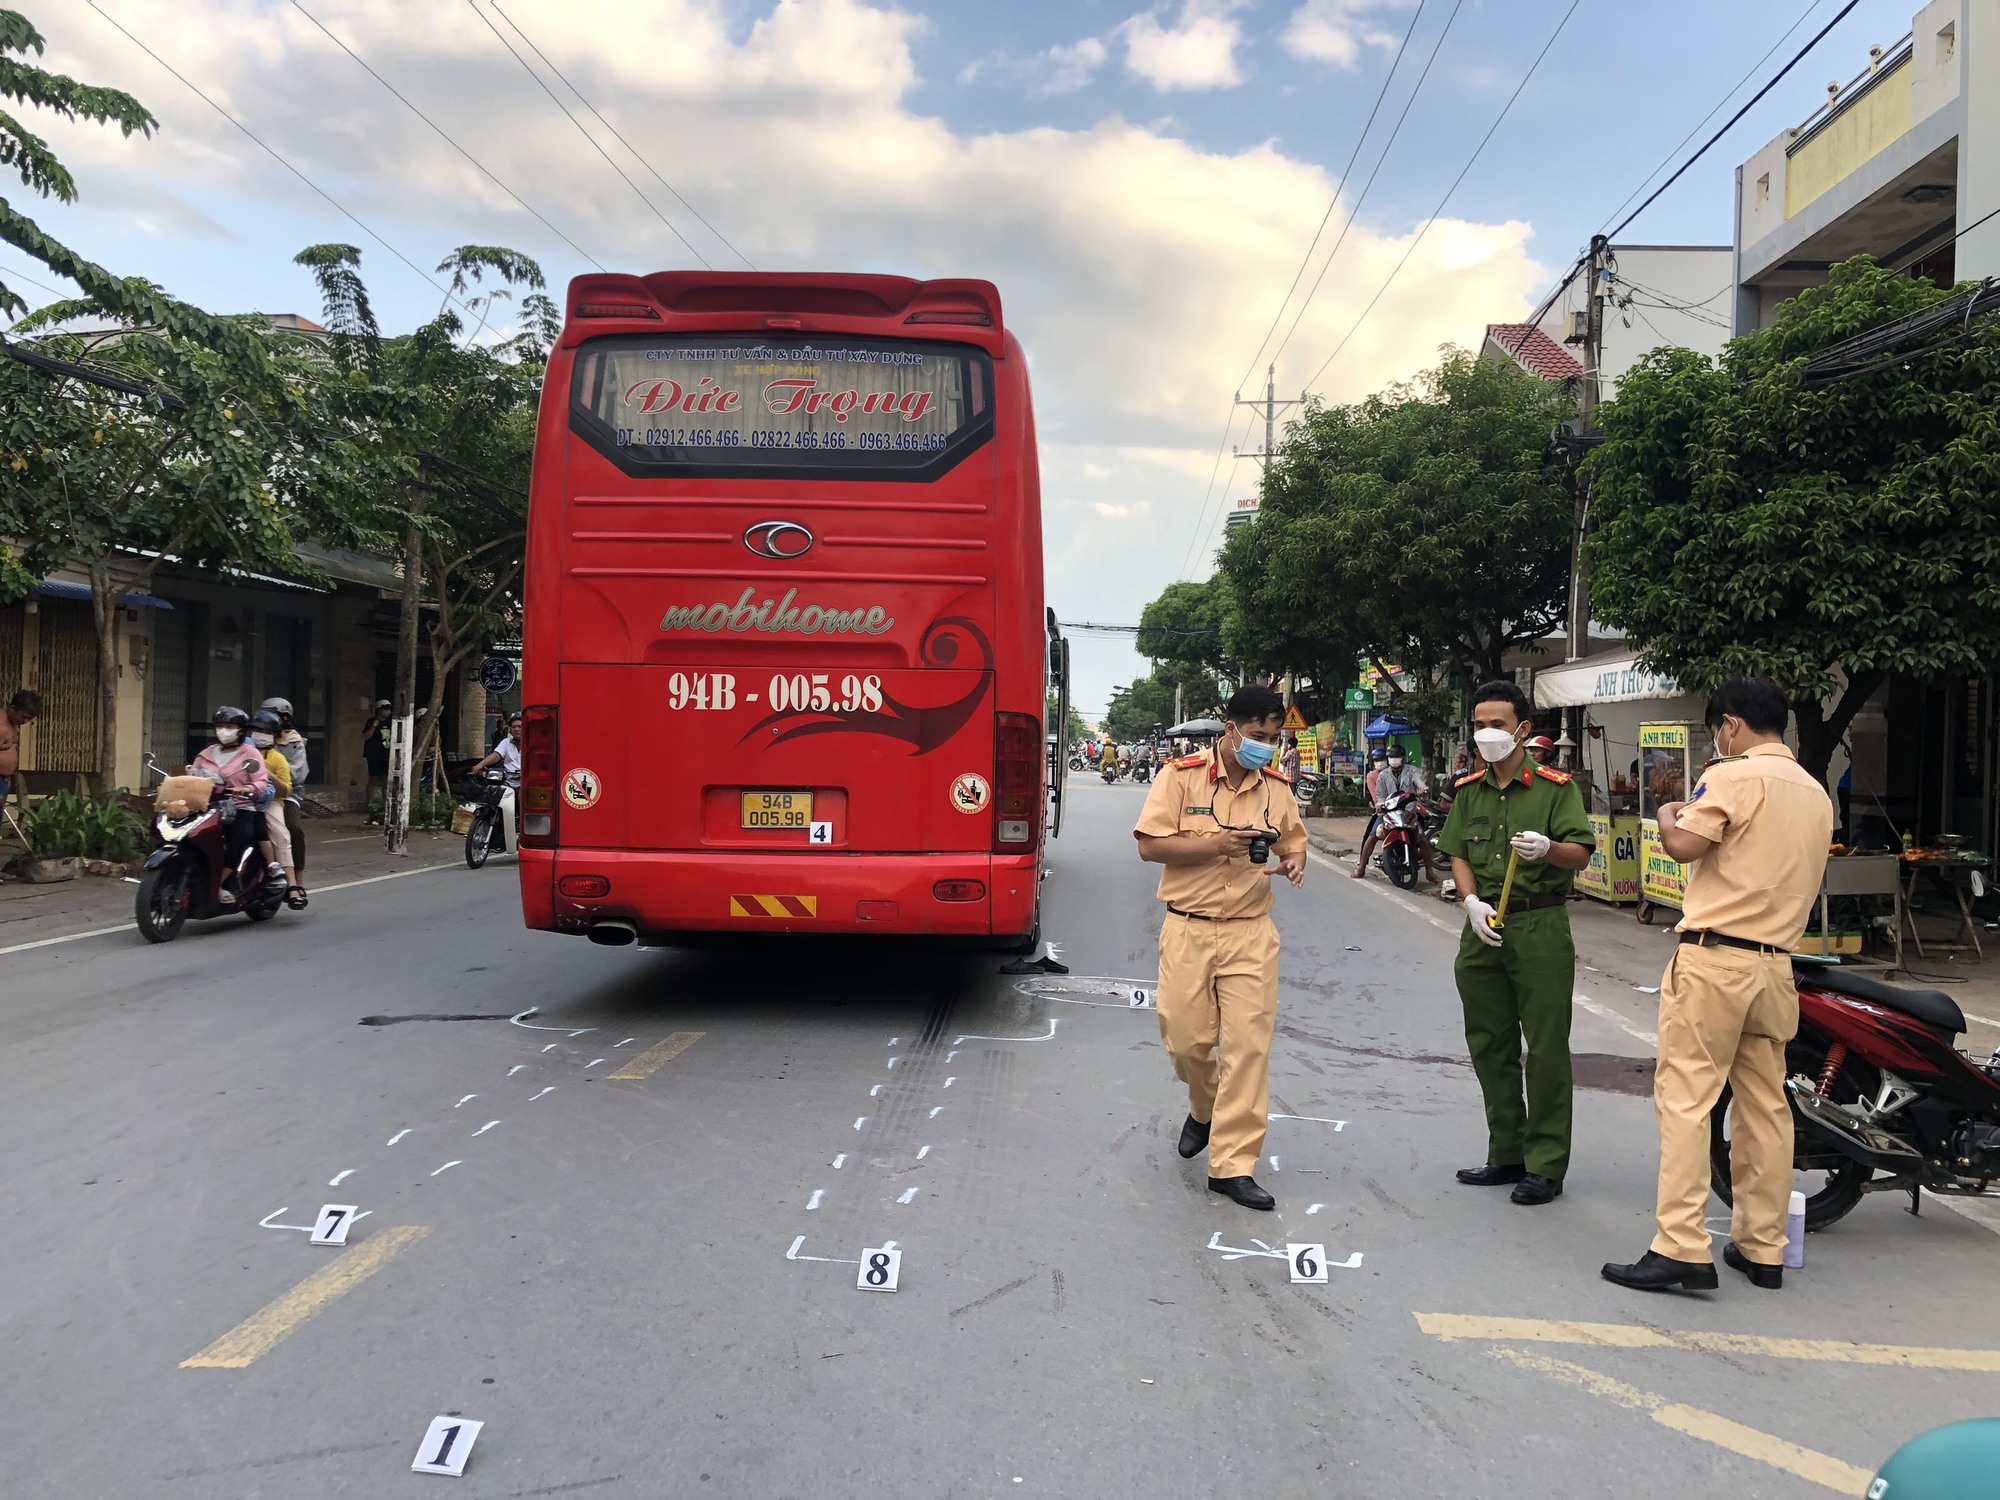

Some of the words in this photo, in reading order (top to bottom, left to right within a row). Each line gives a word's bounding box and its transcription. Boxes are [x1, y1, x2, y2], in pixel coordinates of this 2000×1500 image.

[645, 349, 674, 360] CTY
[678, 349, 716, 360] TNHH
[721, 347, 740, 360] TƯ
[776, 348, 789, 360] &
[826, 349, 847, 362] TƯ
[623, 377, 743, 415] Đức
[763, 378, 937, 424] Trọng
[646, 428, 739, 447] 02912.466.466
[751, 430, 846, 449] 02822.466.466
[859, 432, 947, 451] 0963.466.466
[660, 586, 895, 635] mobihome
[668, 672, 736, 711] 94B
[768, 673, 883, 713] 005.98
[1594, 671, 1618, 697] ANH
[1642, 733, 1659, 744] ANH
[1679, 733, 1684, 745] 3
[762, 795, 792, 809] 94B
[750, 811, 804, 826] 005.98
[814, 824, 827, 842] 4
[1614, 831, 1635, 861] GÀ
[1648, 857, 1660, 872] ANH
[1677, 863, 1682, 877] 3
[1134, 990, 1145, 1006] 9
[325, 1210, 348, 1240] 7
[866, 1253, 890, 1285] 8
[1296, 1247, 1317, 1278] 6
[427, 1425, 462, 1467] 1
